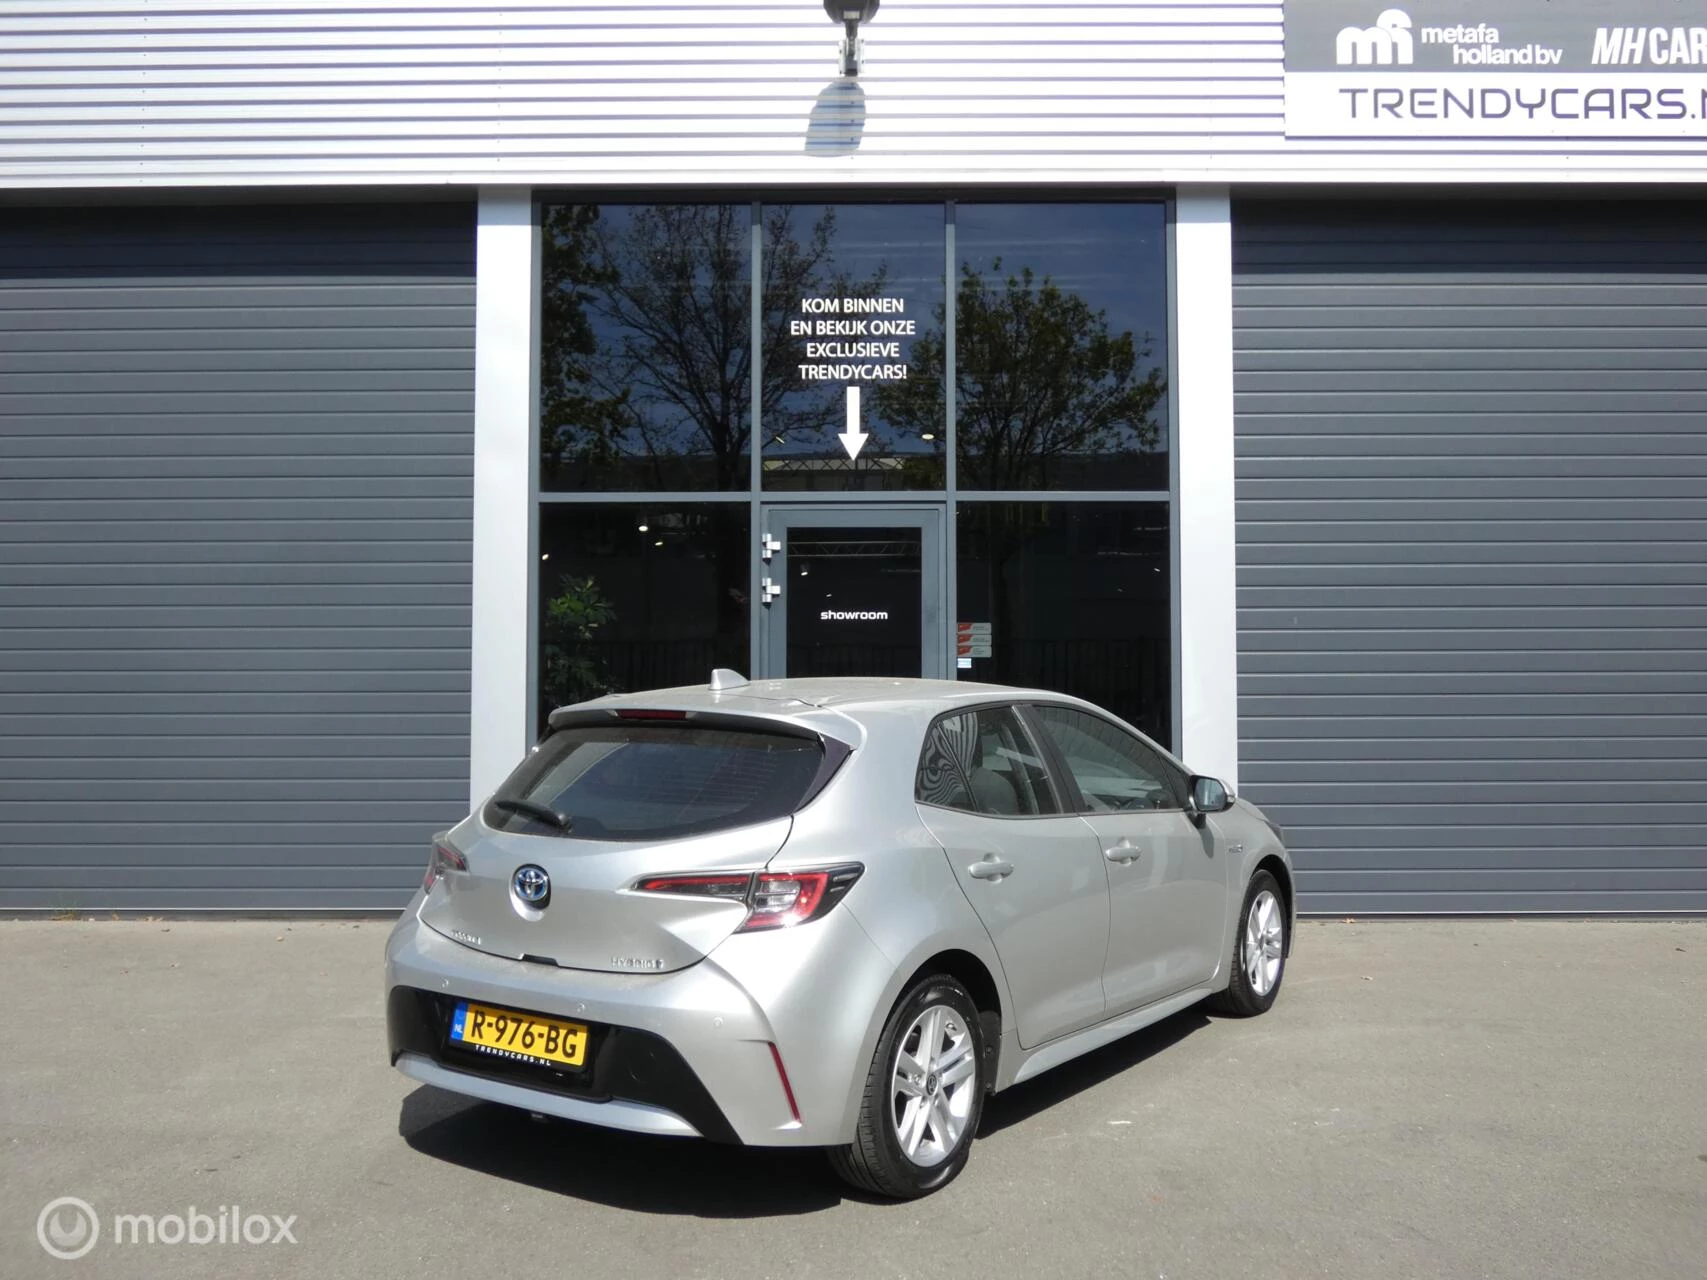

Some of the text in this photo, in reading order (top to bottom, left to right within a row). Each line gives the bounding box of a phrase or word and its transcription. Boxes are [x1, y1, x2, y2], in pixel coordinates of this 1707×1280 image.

[1421, 23, 1499, 43] metafa
[1339, 88, 1707, 119] TRENDYCARS.
[802, 298, 904, 313] KOM BINNEN
[791, 320, 915, 335] EN BEKIJK ONZE
[806, 342, 899, 357] EXCLUSIEVE
[799, 364, 907, 379] TRENDYCARS!
[820, 610, 888, 620] showroom
[471, 1010, 578, 1059] R-976-BG
[475, 1044, 551, 1066] TRENDYCARS.NL
